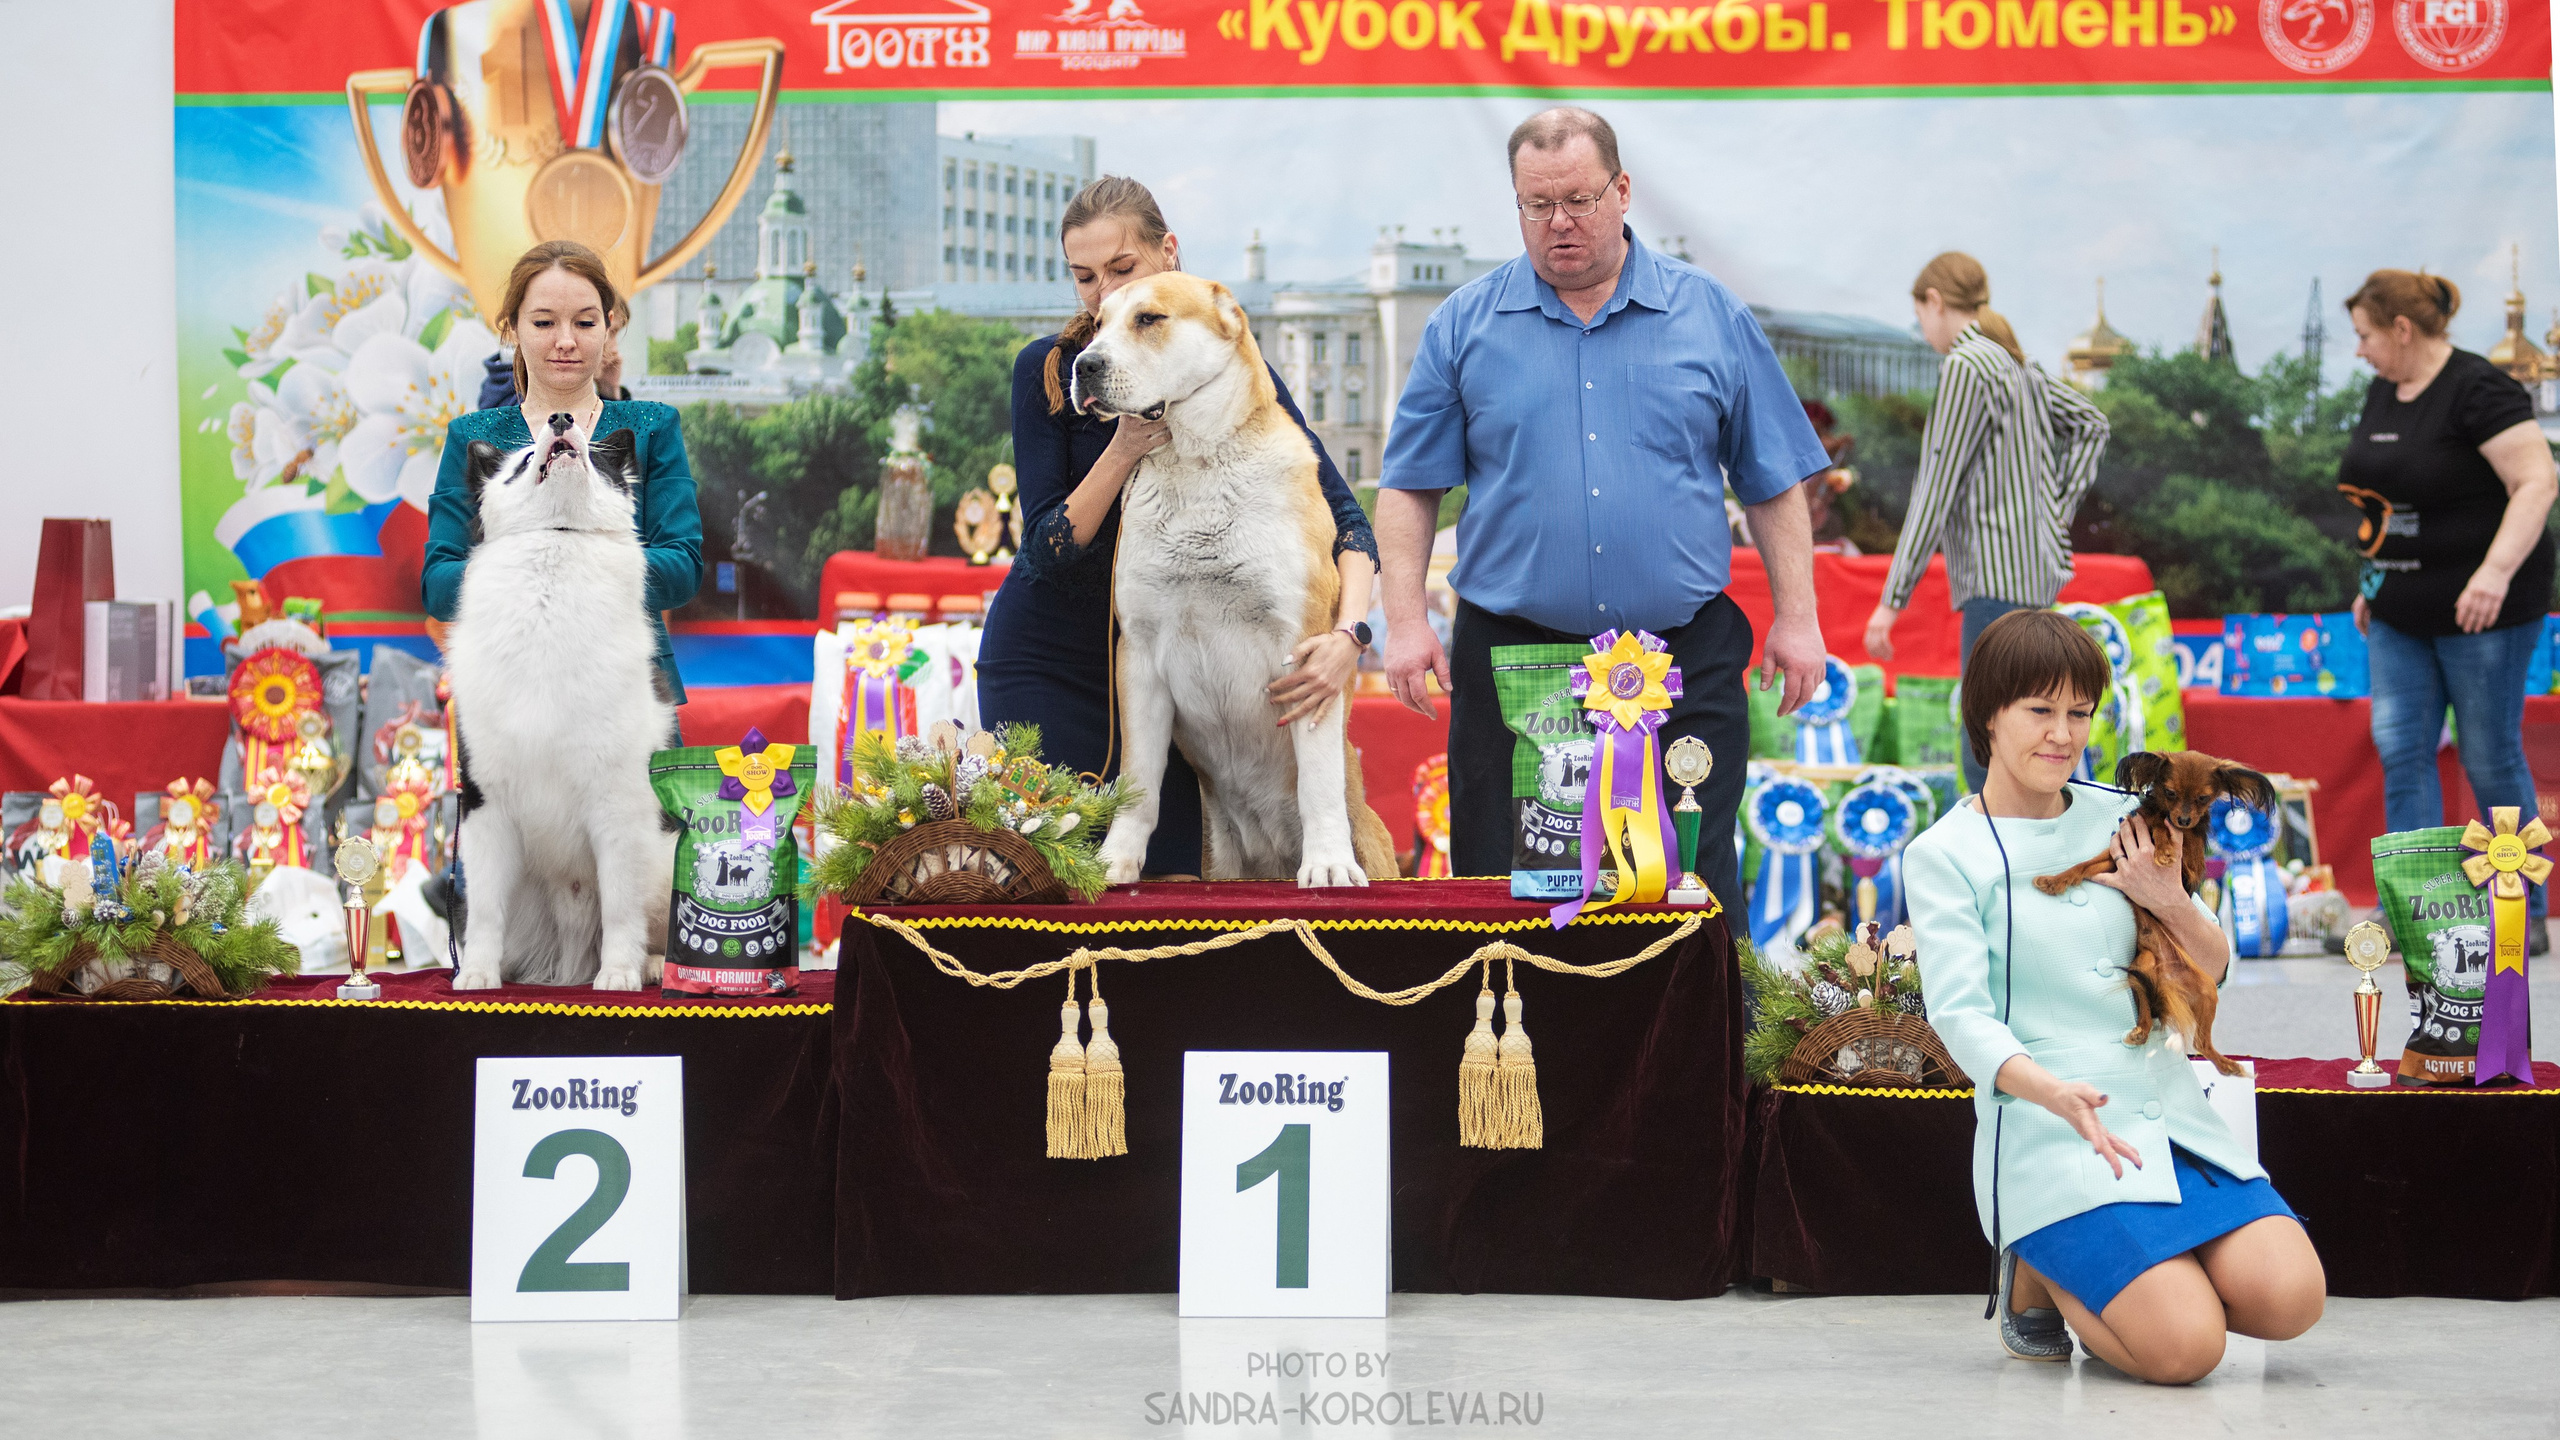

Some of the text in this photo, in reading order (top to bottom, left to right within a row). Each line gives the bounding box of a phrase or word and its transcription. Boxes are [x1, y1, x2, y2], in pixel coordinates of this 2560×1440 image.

[2426, 0, 2478, 24] FCI
[1016, 27, 1186, 54] МИР ЖИВОЙ ПРИРОДЫ
[1217, 0, 1486, 64] «Кубок
[1502, 0, 1851, 66] Дружбы.
[1873, 0, 2238, 50] Тюмень»
[1060, 55, 1140, 71] ЗООЦЕНТР
[1542, 687, 1571, 708] SUPER
[1525, 708, 1597, 736] ZooR
[1574, 754, 1593, 762] ZooRin
[697, 791, 720, 806] SUPE
[682, 806, 787, 839] ZooRg
[1545, 815, 1573, 830] DOG
[729, 854, 752, 862] ZooRing
[1547, 875, 1583, 887] PUPPY
[2423, 873, 2452, 892] SUPER
[2409, 893, 2490, 922] ZooRi
[698, 913, 767, 930] DOG FOOD
[2465, 940, 2488, 948] ZooRing
[715, 969, 763, 984] FORMULA
[2440, 1001, 2469, 1017] DOG
[2425, 1059, 2464, 1074] ACTIVE
[512, 1078, 639, 1117] ZooRing
[1219, 1073, 1346, 1113] ZooRing
[516, 1128, 632, 1293] 2
[1236, 1124, 1311, 1289] 1
